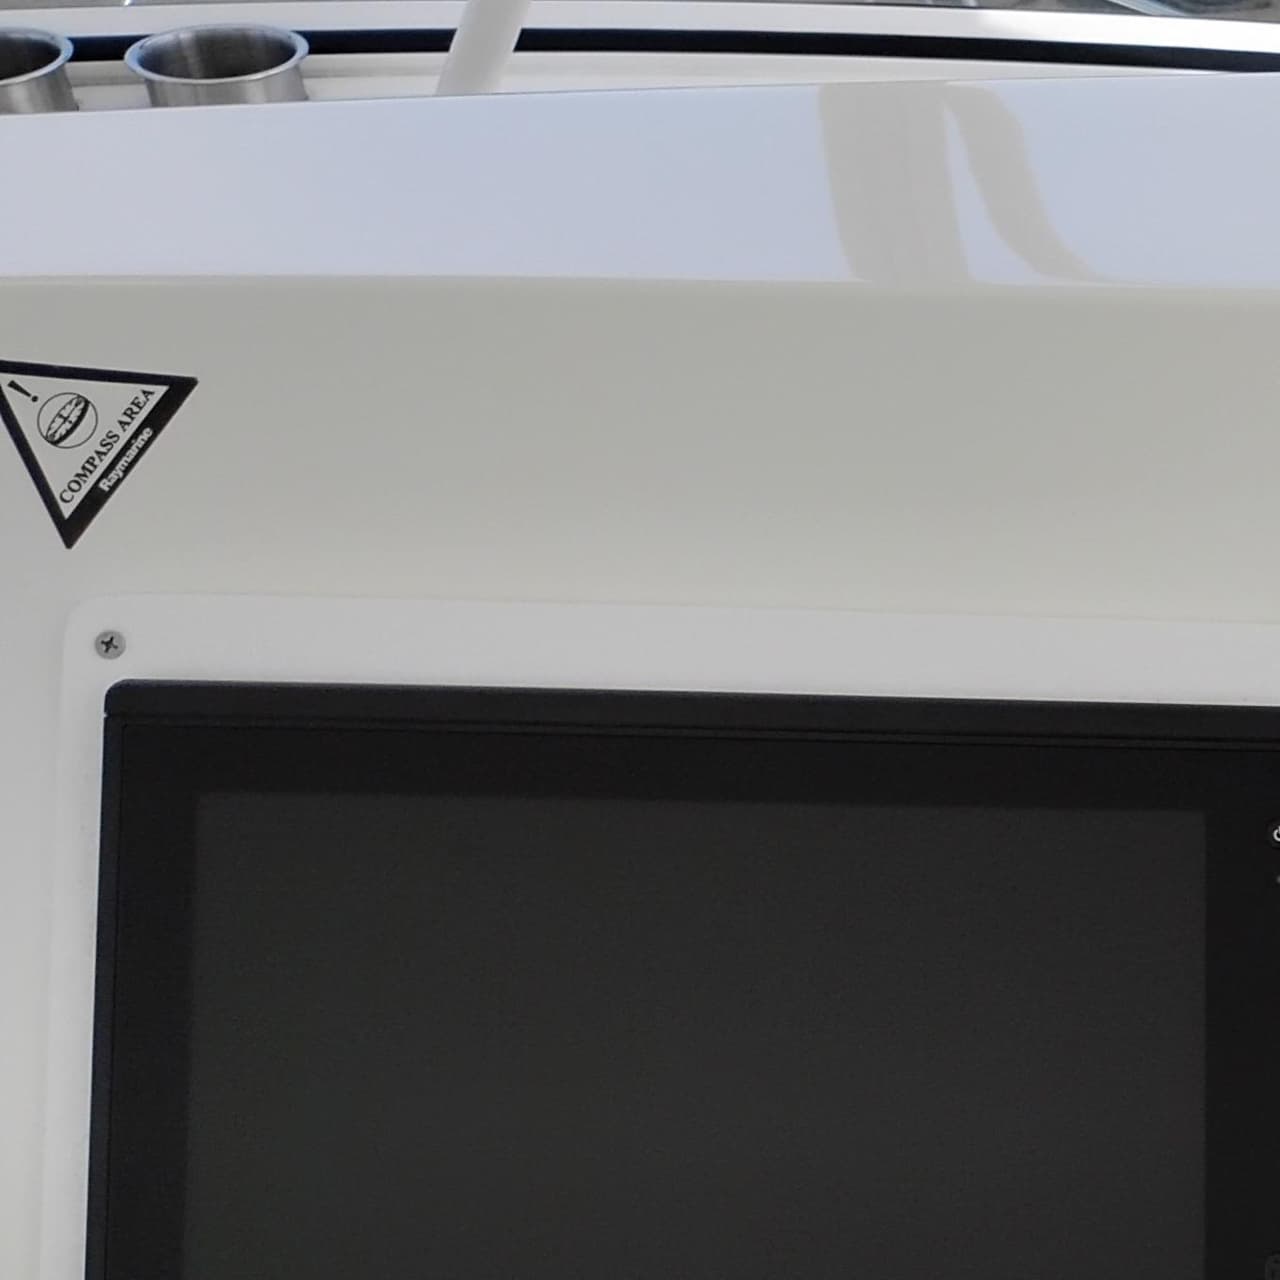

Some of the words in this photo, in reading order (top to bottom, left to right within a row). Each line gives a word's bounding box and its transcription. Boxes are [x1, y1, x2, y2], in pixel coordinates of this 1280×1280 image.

[59, 430, 120, 503] COMPASS
[118, 388, 155, 432] AREA
[99, 427, 154, 492] Raymarine
